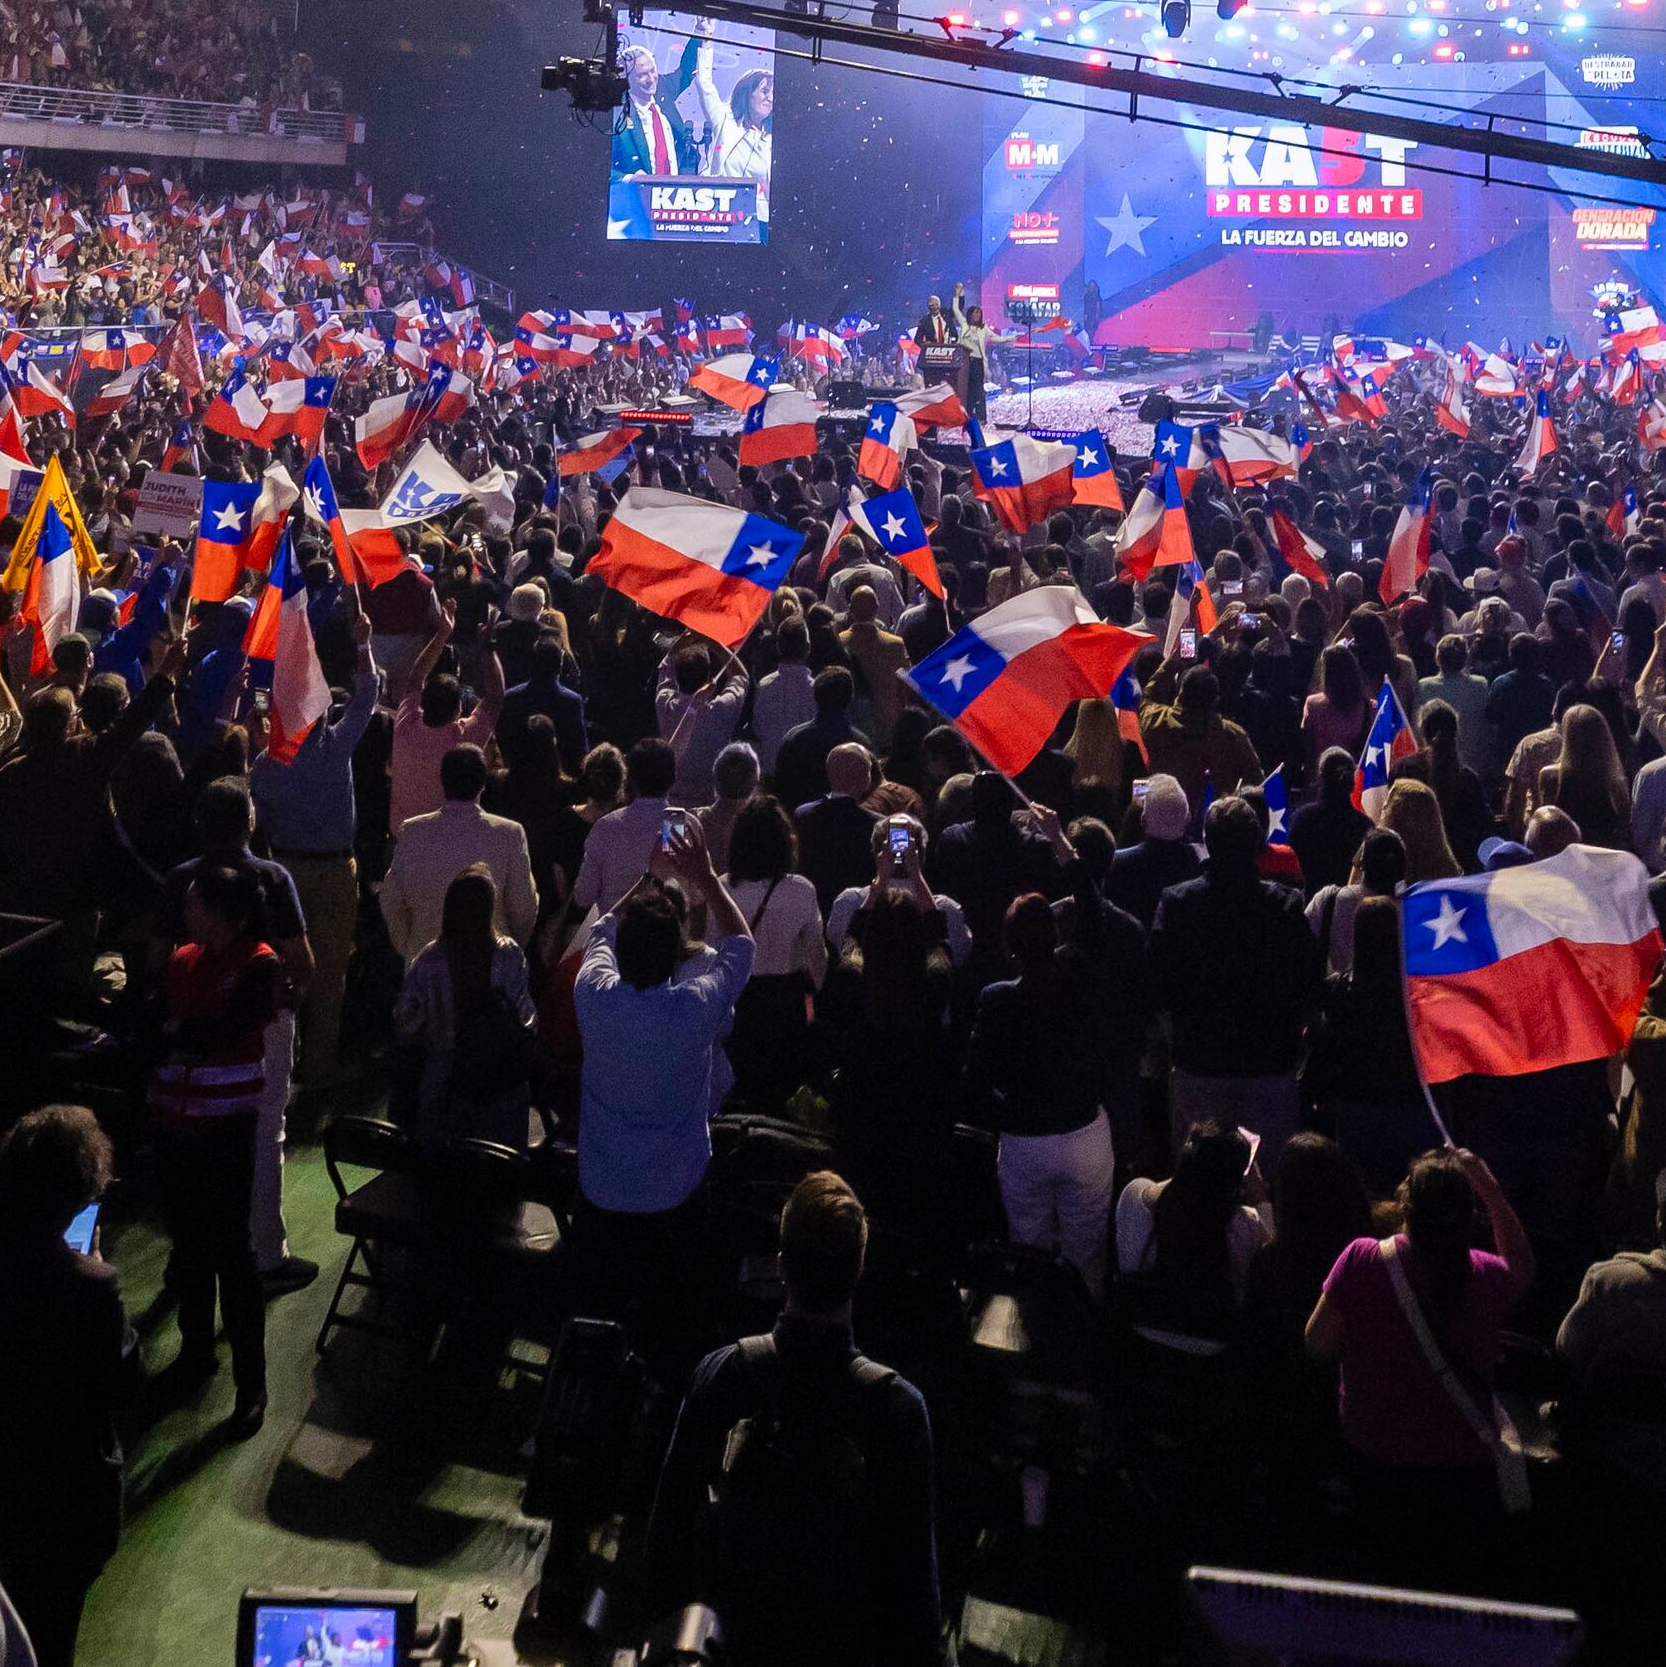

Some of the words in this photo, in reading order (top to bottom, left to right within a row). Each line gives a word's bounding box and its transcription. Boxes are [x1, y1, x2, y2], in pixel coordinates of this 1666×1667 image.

[651, 187, 737, 212] KAST
[1215, 194, 1414, 214] PRESIDENTE
[1221, 229, 1240, 245] LA
[1244, 230, 1306, 246] FUERZA
[1310, 231, 1341, 246] DEL
[1344, 231, 1409, 248] CAMBIO
[1576, 221, 1648, 240] DORADA
[925, 347, 957, 356] KAST
[144, 481, 188, 496] JUDITH
